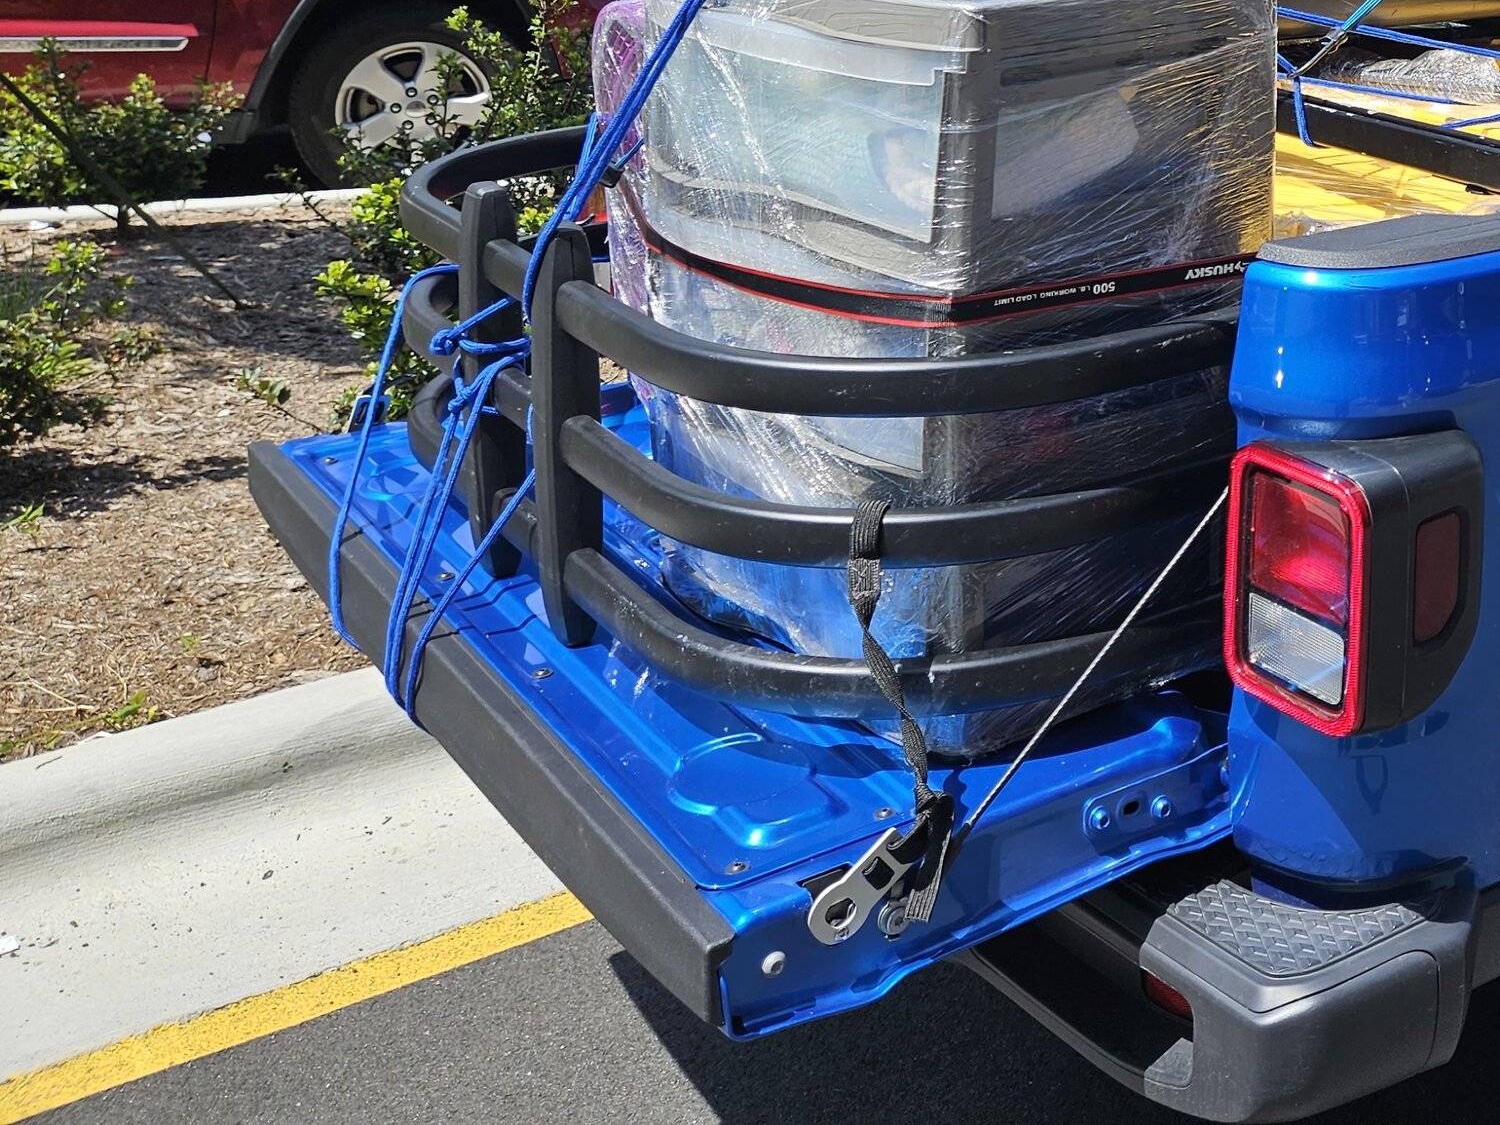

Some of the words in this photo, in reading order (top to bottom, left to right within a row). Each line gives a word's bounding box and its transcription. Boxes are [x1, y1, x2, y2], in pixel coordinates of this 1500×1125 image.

[1184, 263, 1234, 280] HUSKY
[1040, 287, 1077, 299] WORKING
[1092, 281, 1116, 295] 500
[993, 297, 1015, 306] LIMIT
[1016, 294, 1037, 302] LOAD
